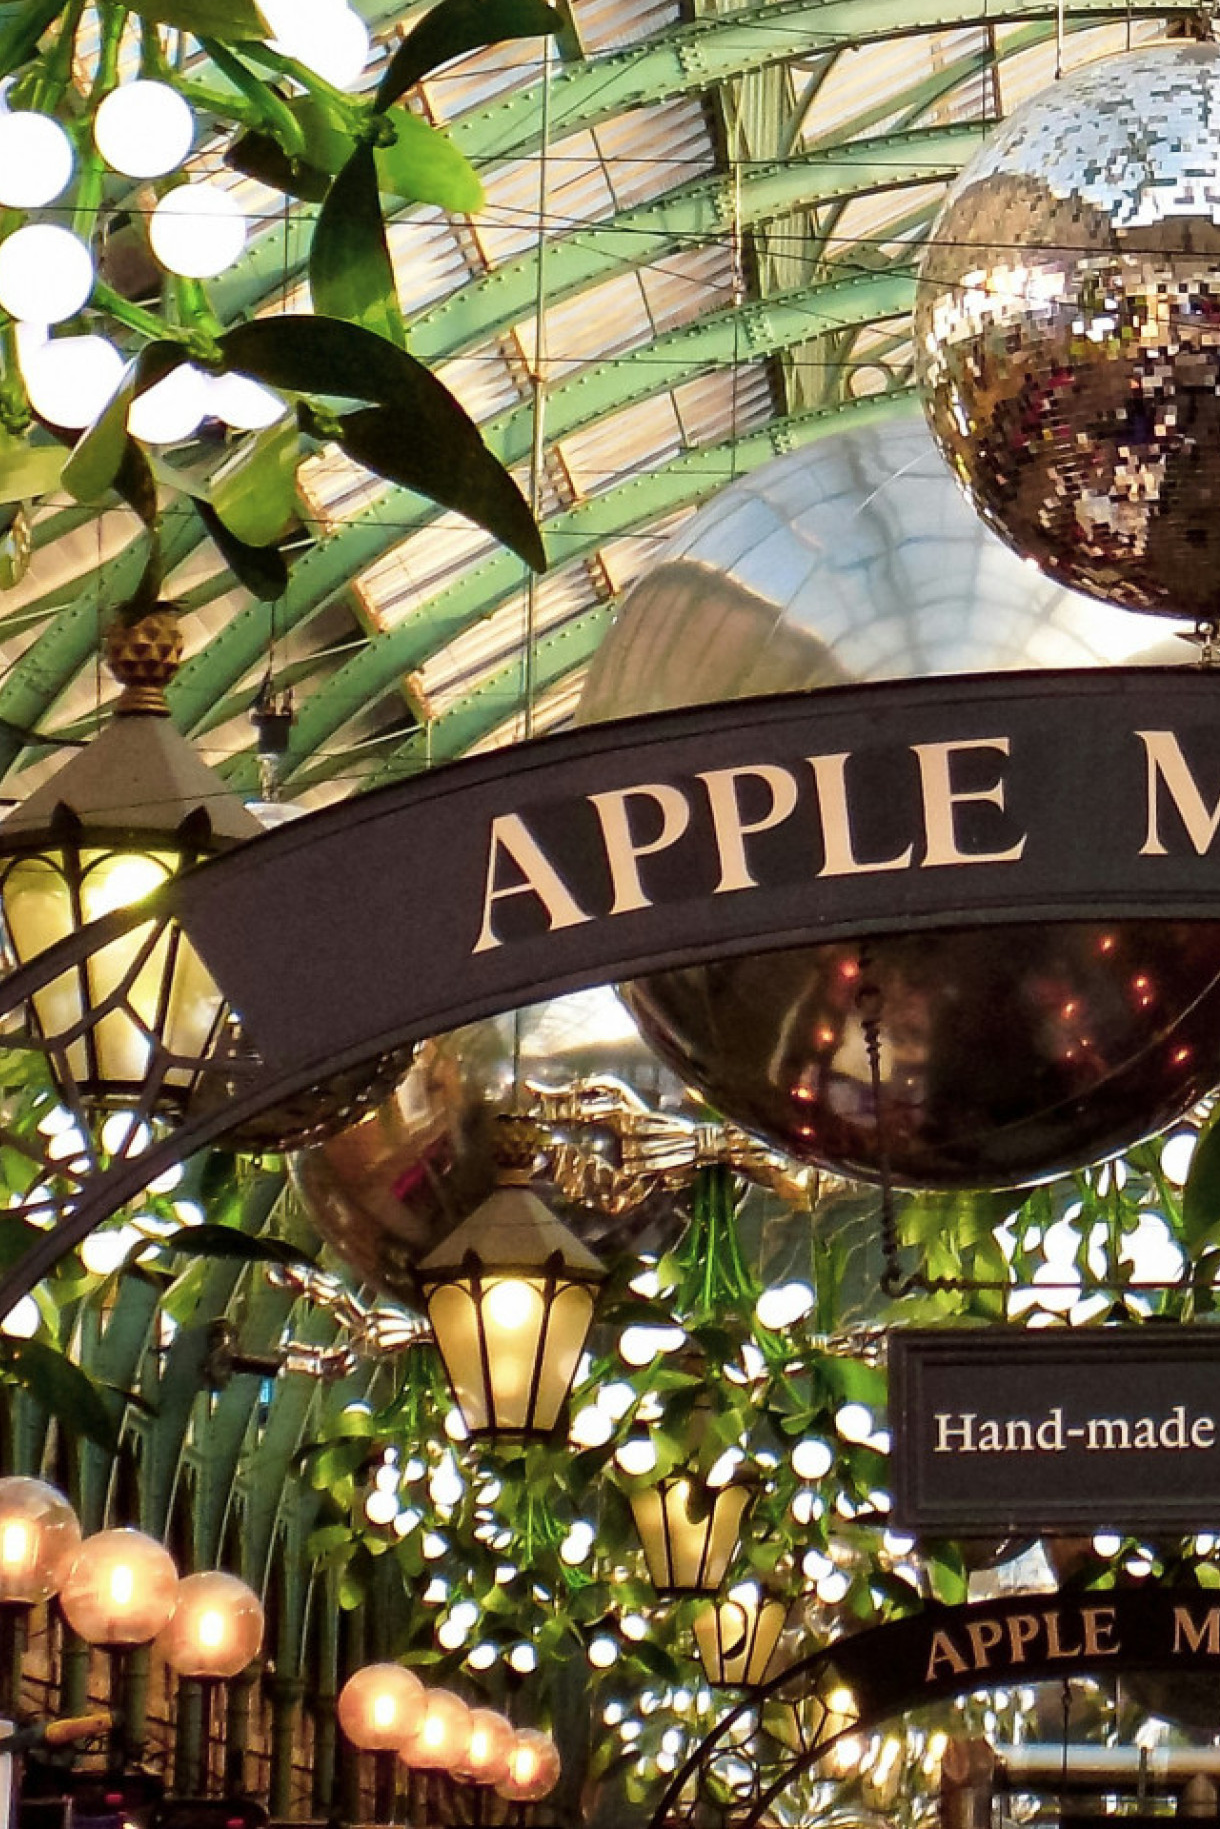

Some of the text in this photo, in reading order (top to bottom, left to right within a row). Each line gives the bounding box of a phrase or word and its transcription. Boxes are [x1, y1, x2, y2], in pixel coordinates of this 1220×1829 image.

[472, 737, 1027, 953] APPLE
[934, 1406, 1214, 1452] Hand-made
[926, 1608, 1120, 1680] APPLE
